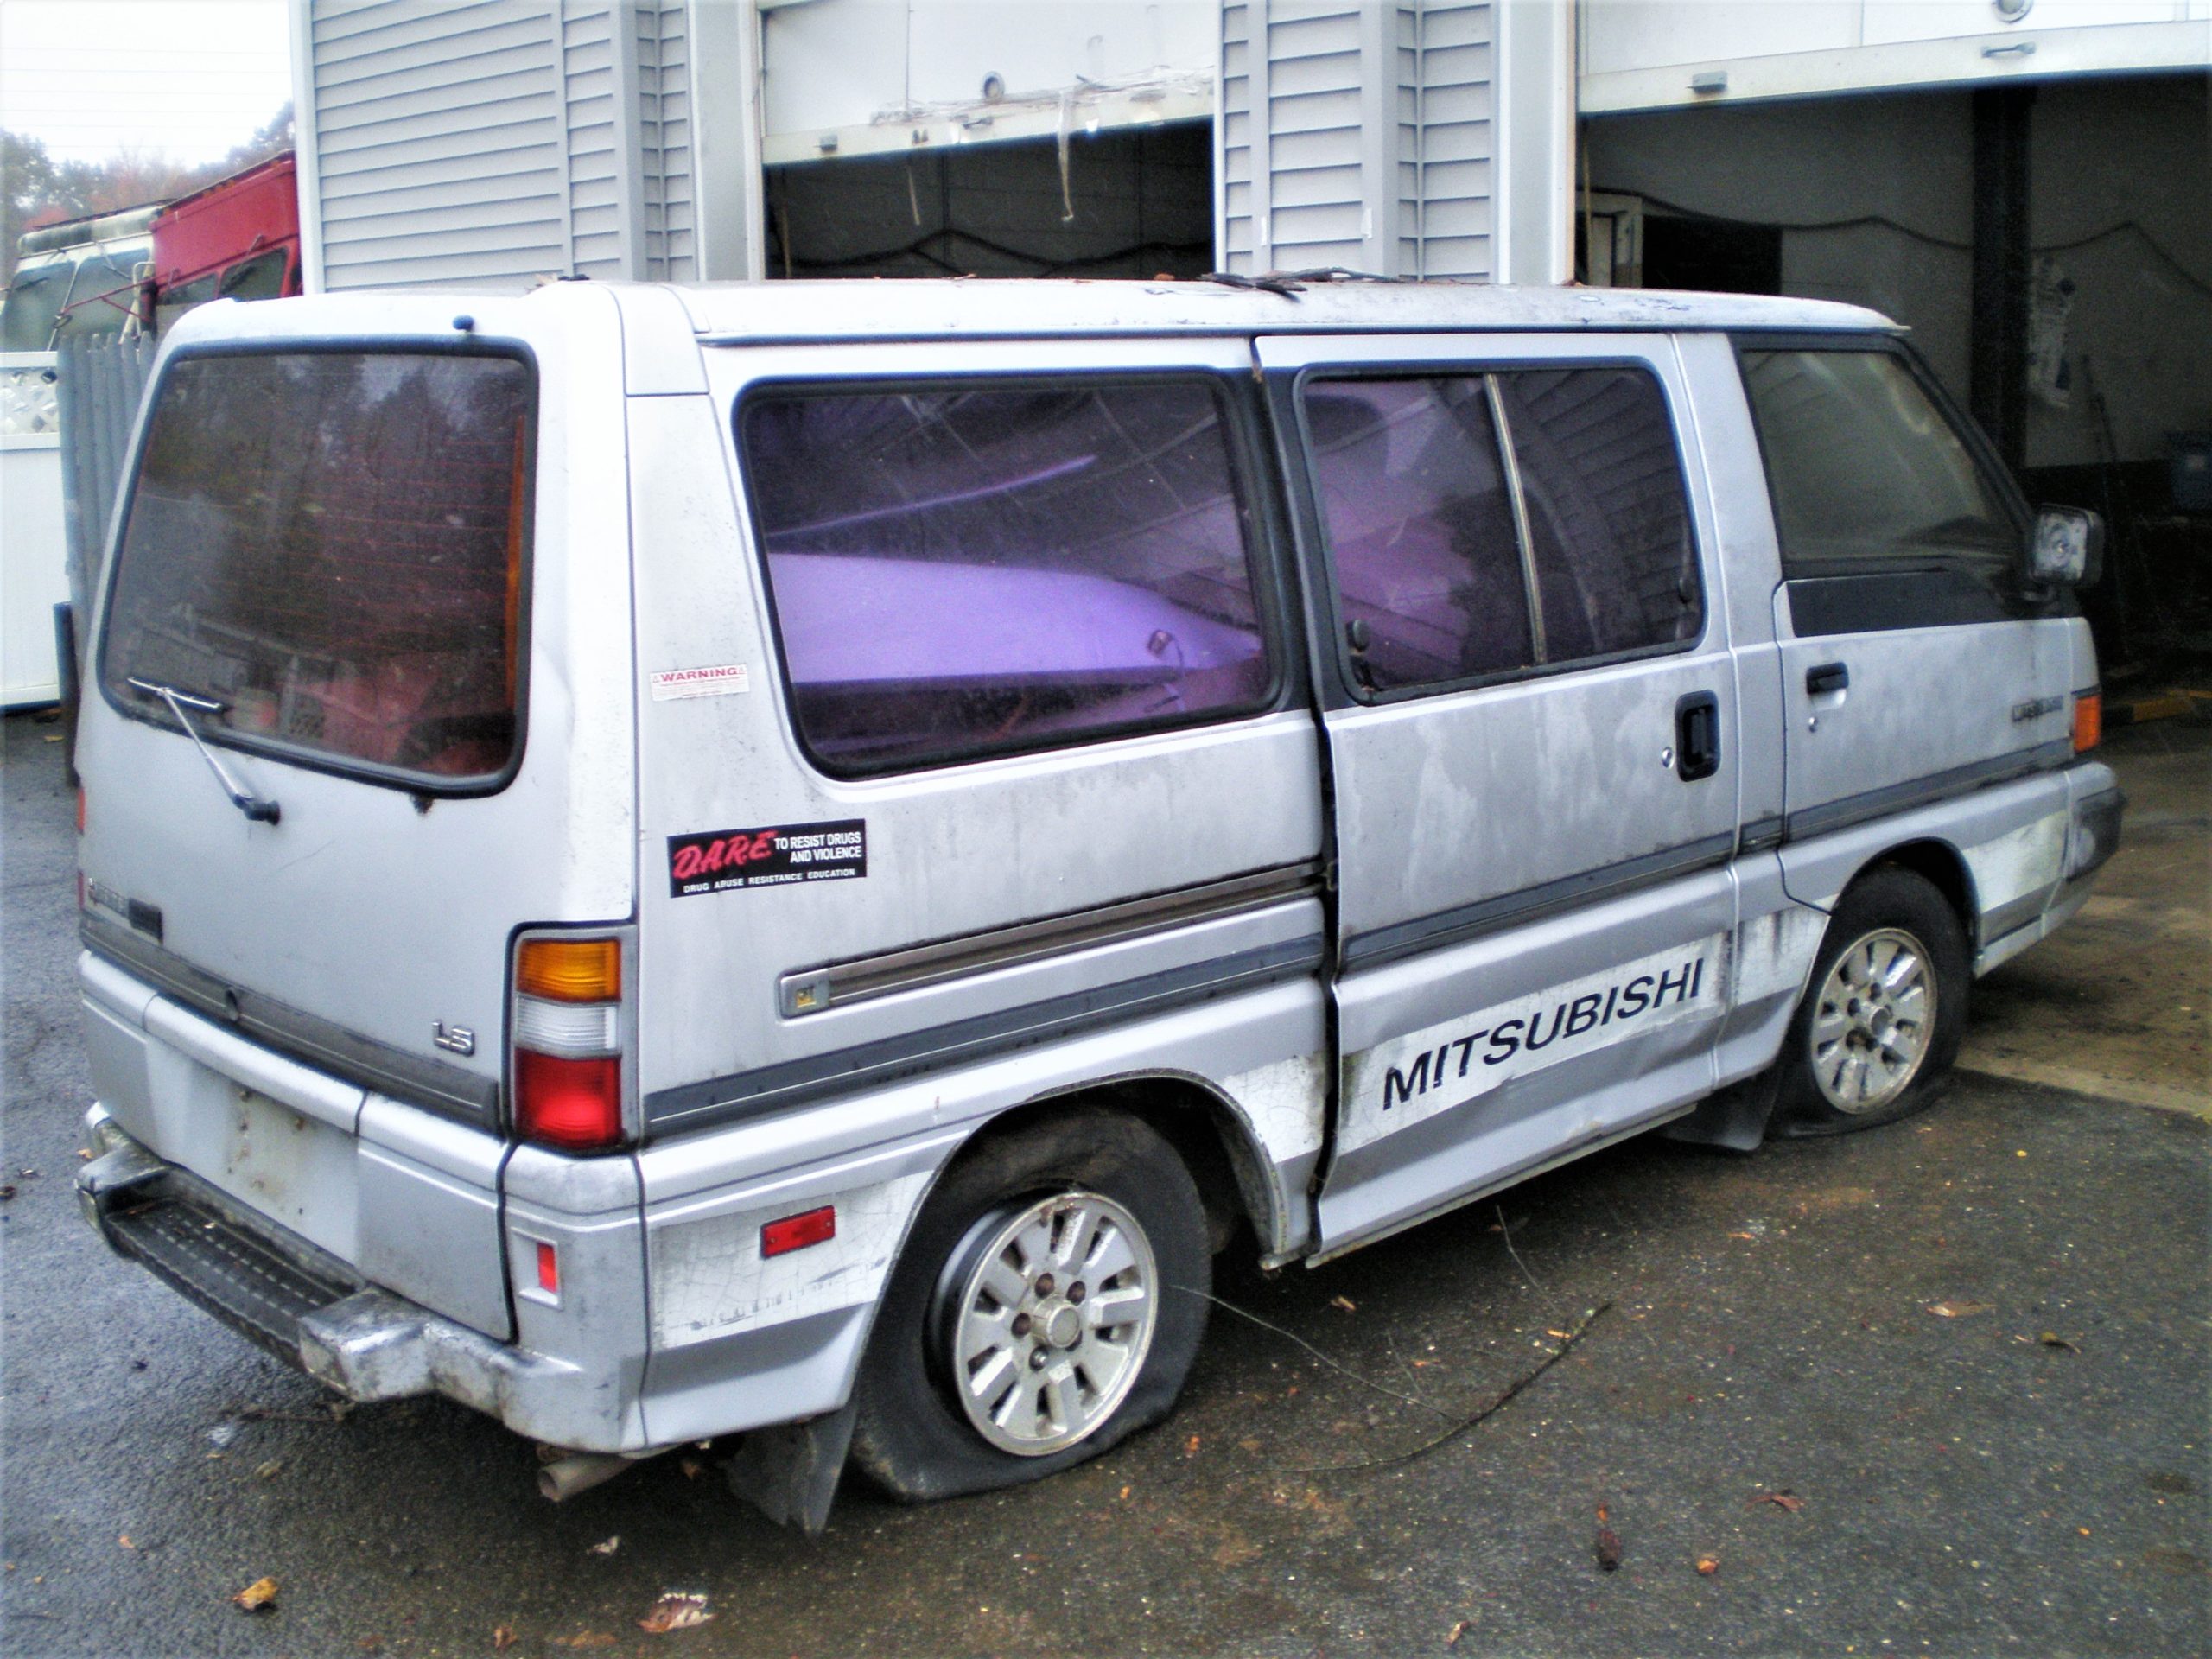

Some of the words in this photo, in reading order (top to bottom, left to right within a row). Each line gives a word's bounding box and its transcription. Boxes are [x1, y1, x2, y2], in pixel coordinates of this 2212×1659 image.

[661, 668, 737, 681] WARNING
[774, 837, 788, 850] TO
[790, 835, 825, 849] RESIST
[827, 832, 861, 846] DRUGS
[790, 850, 812, 863] AND
[813, 846, 861, 861] VIOLENCE
[683, 883, 709, 893] DRUG
[714, 878, 744, 889] ABUSE
[748, 872, 803, 885] RESISTANCE
[807, 868, 855, 880] EDUCATION
[432, 1020, 474, 1057] LS
[1383, 958, 1704, 1111] MITSUBISHI
